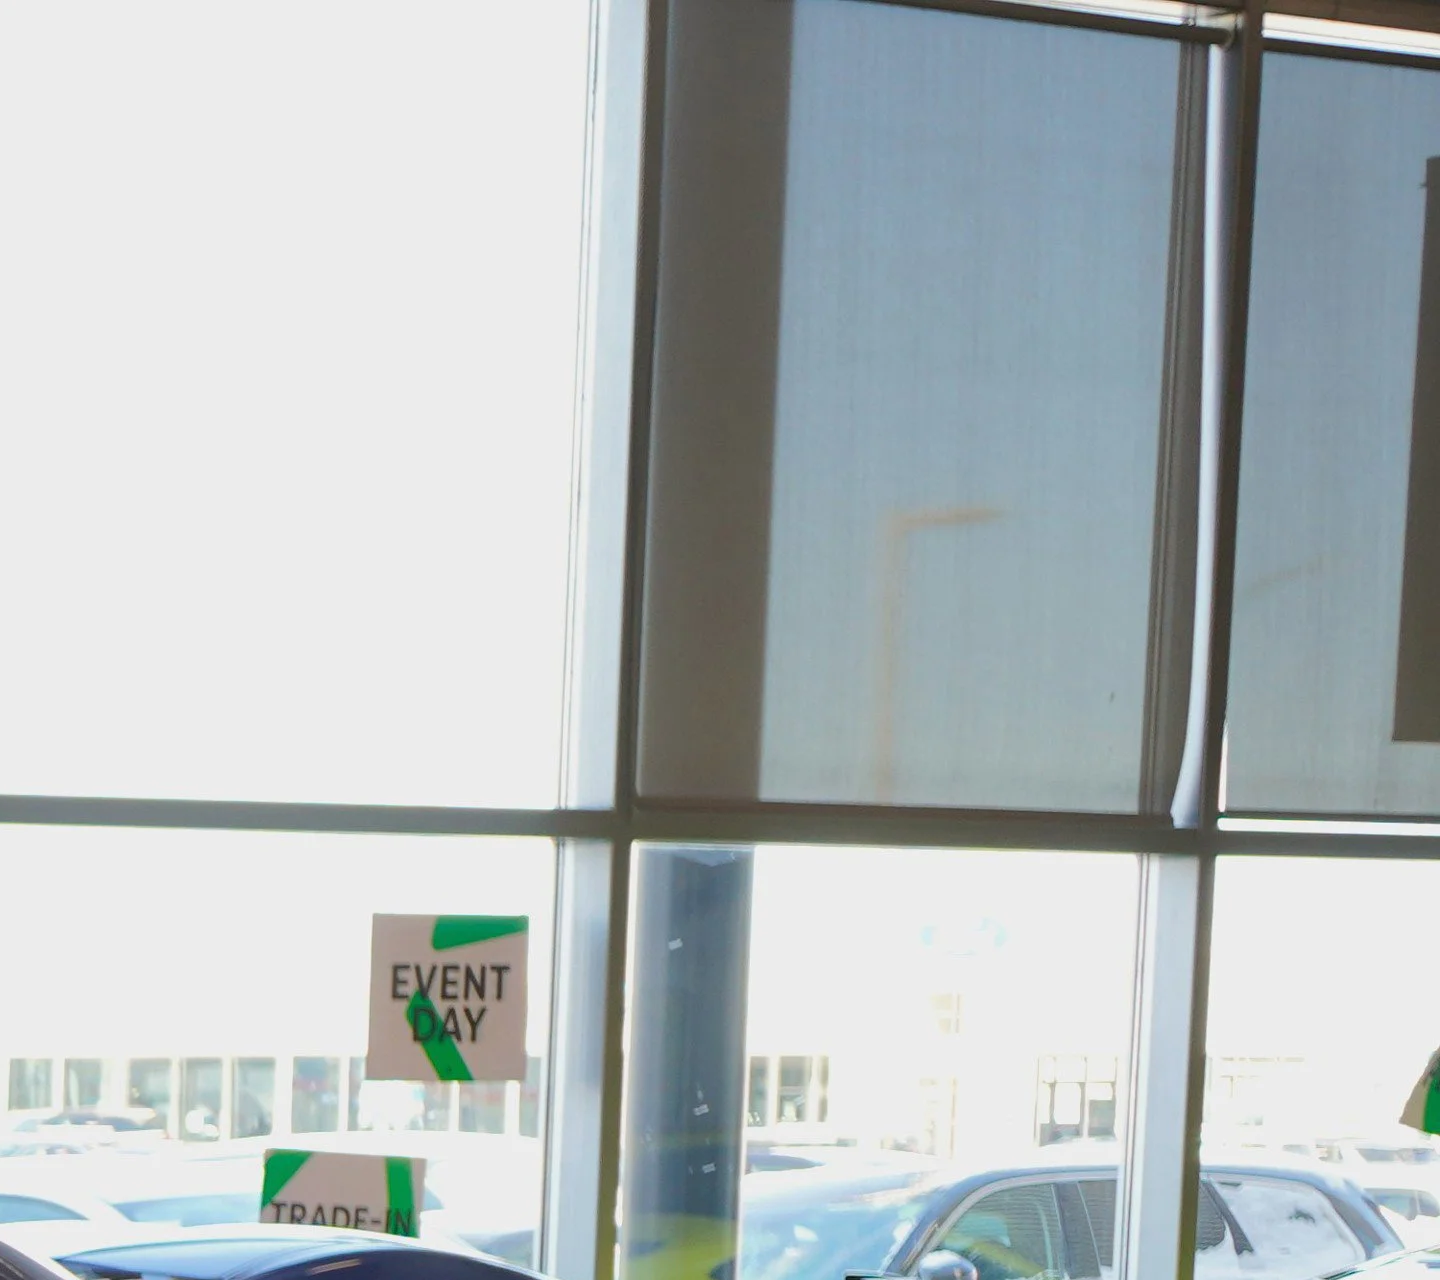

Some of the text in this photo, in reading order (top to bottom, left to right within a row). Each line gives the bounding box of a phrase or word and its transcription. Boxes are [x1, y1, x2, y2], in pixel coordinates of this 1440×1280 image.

[391, 963, 512, 1000] EVENT
[412, 1005, 488, 1043] DAY
[271, 1201, 413, 1235] TRADE-IN
